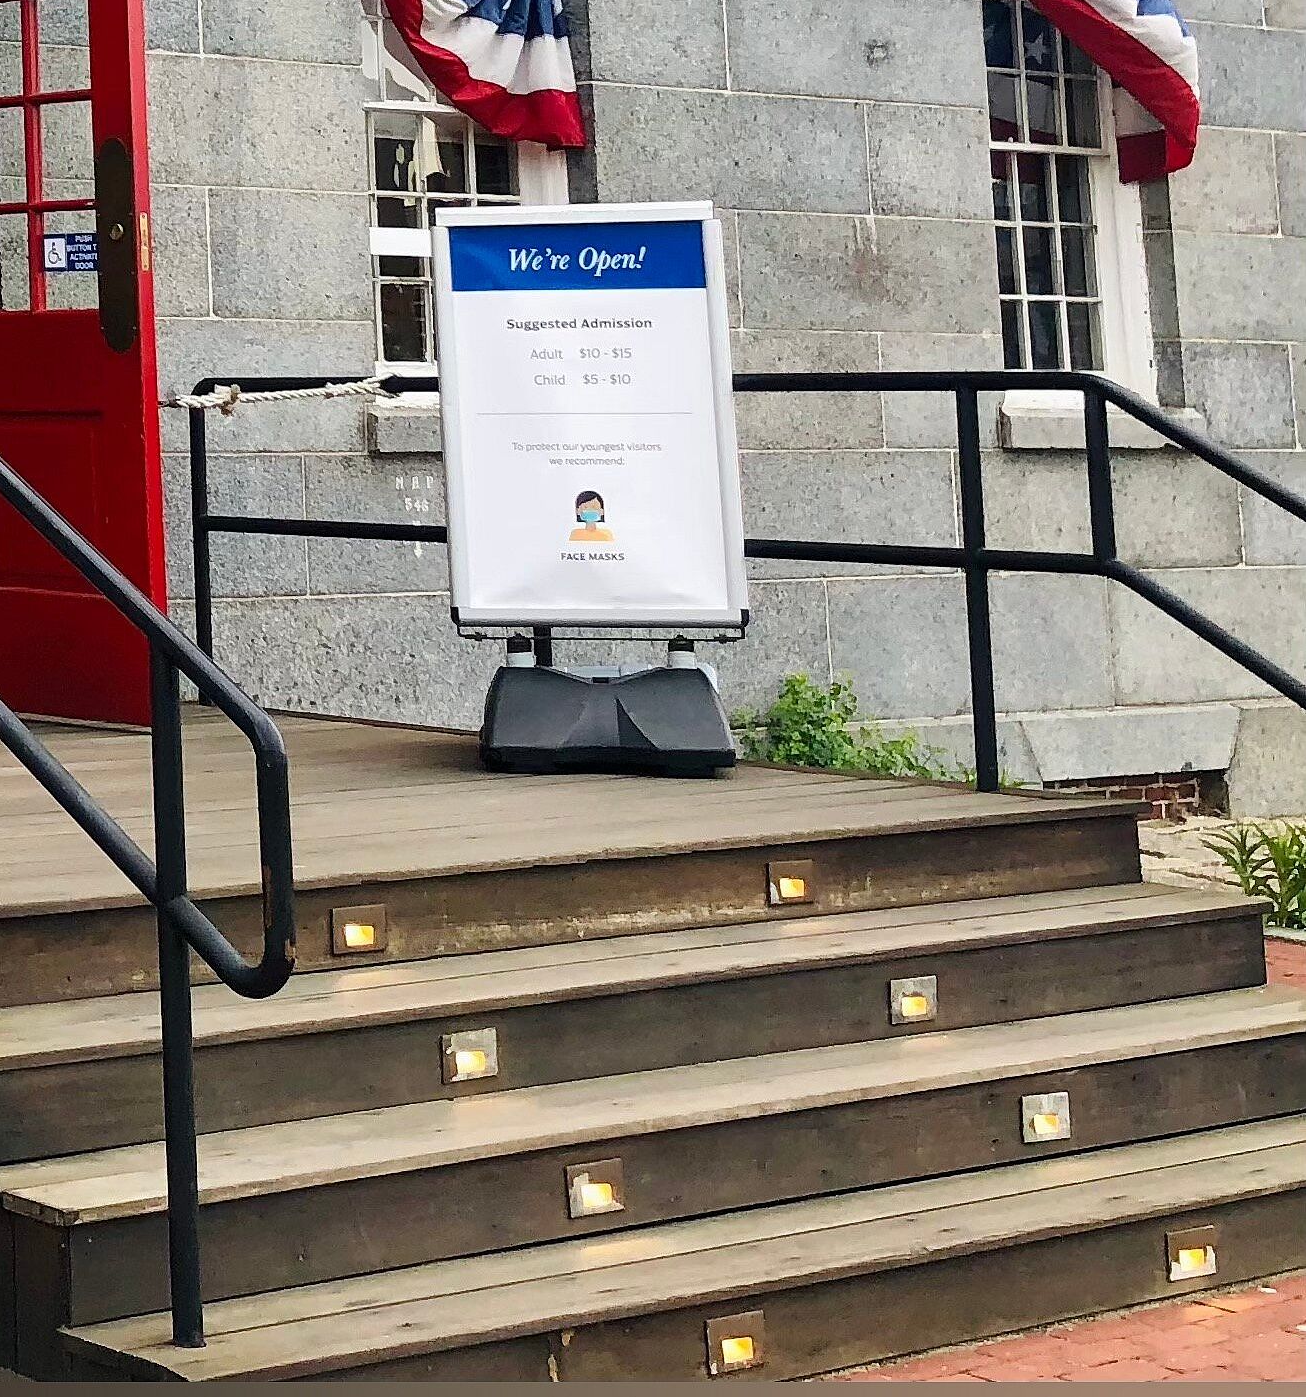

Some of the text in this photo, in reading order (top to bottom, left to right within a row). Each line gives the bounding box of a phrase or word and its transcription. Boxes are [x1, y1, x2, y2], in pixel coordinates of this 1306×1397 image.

[66, 244, 92, 252] BUTTON
[578, 246, 647, 277] Open!
[506, 317, 653, 331] Suggested Admission
[530, 348, 564, 360] Adult
[579, 347, 600, 360] $10
[611, 347, 632, 359] $15
[534, 374, 566, 386] Child
[582, 373, 599, 385] $5
[610, 373, 631, 385] $10
[511, 441, 662, 453] To protect our youngest visitors
[560, 552, 626, 561] FACE MASKS
